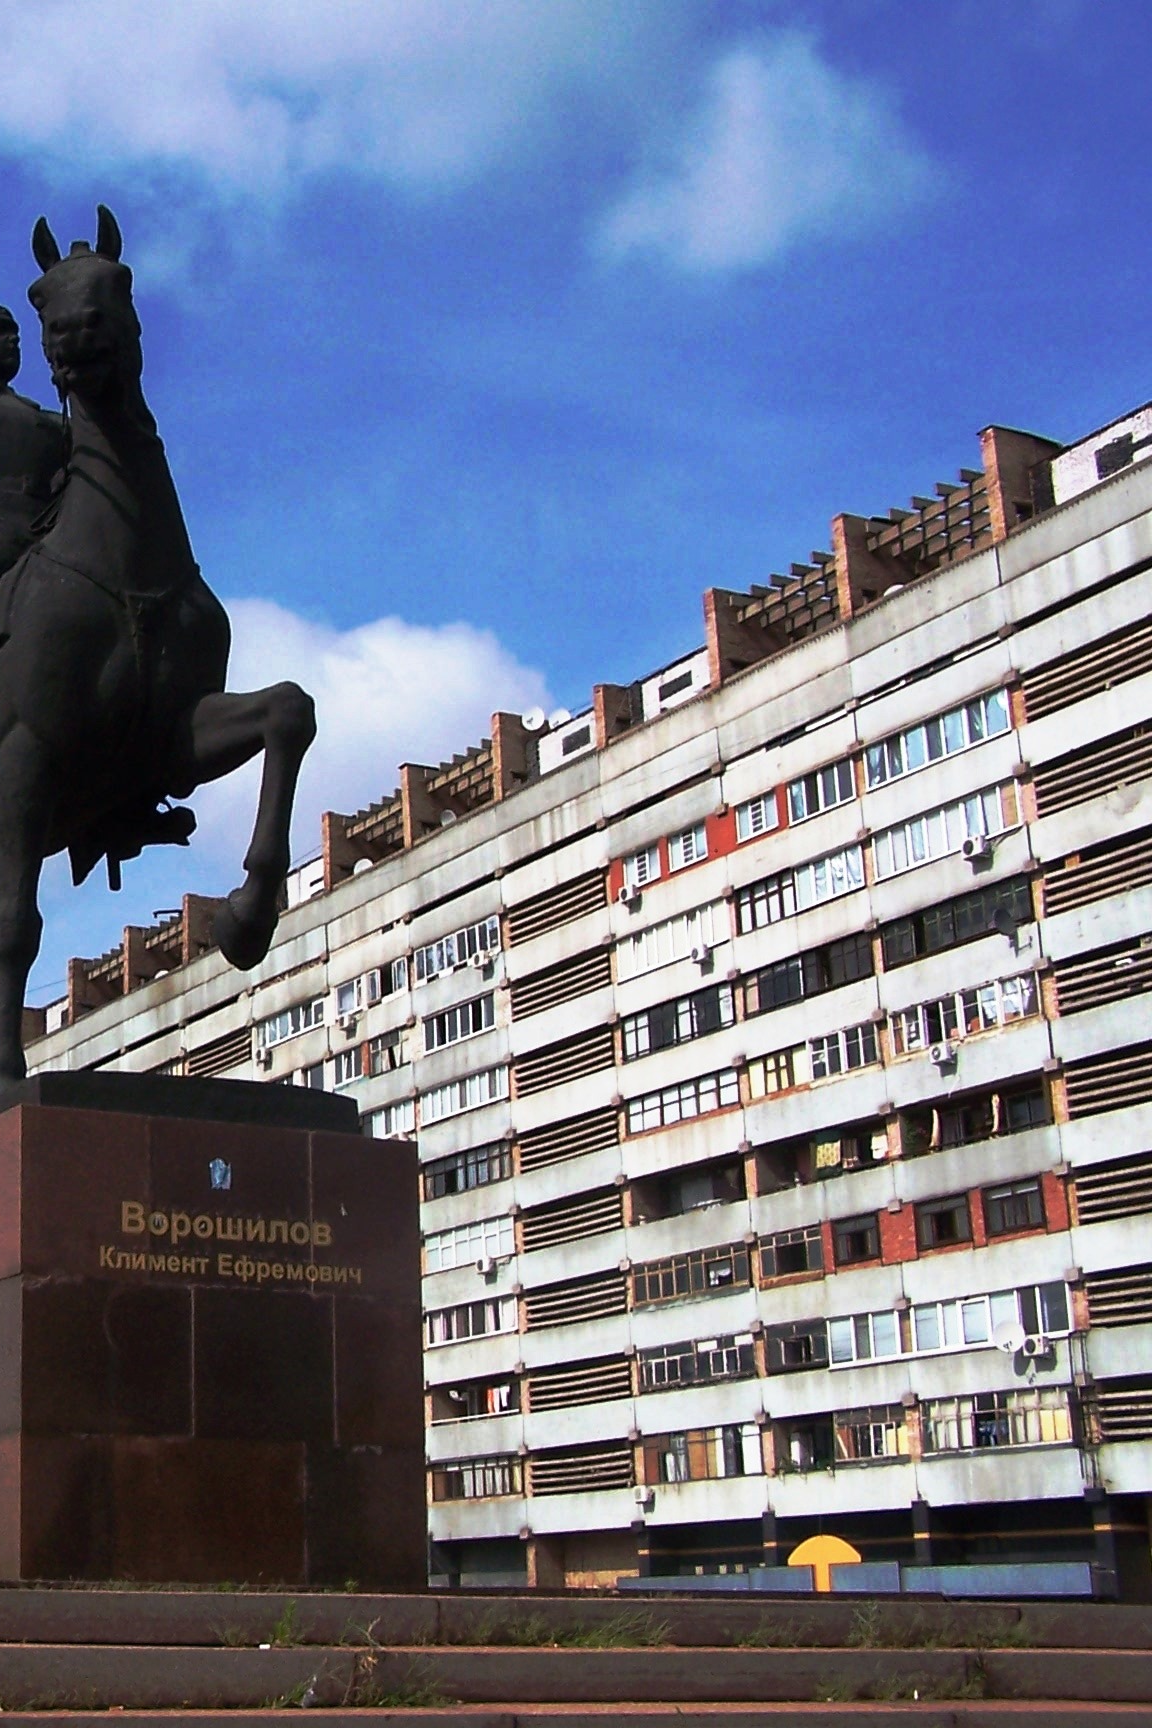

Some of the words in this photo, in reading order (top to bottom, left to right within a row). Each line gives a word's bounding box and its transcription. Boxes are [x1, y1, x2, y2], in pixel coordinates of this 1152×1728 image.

[121, 1201, 333, 1246] Ворошилов
[99, 1245, 209, 1275] Климент
[218, 1253, 362, 1283] Ефремович
